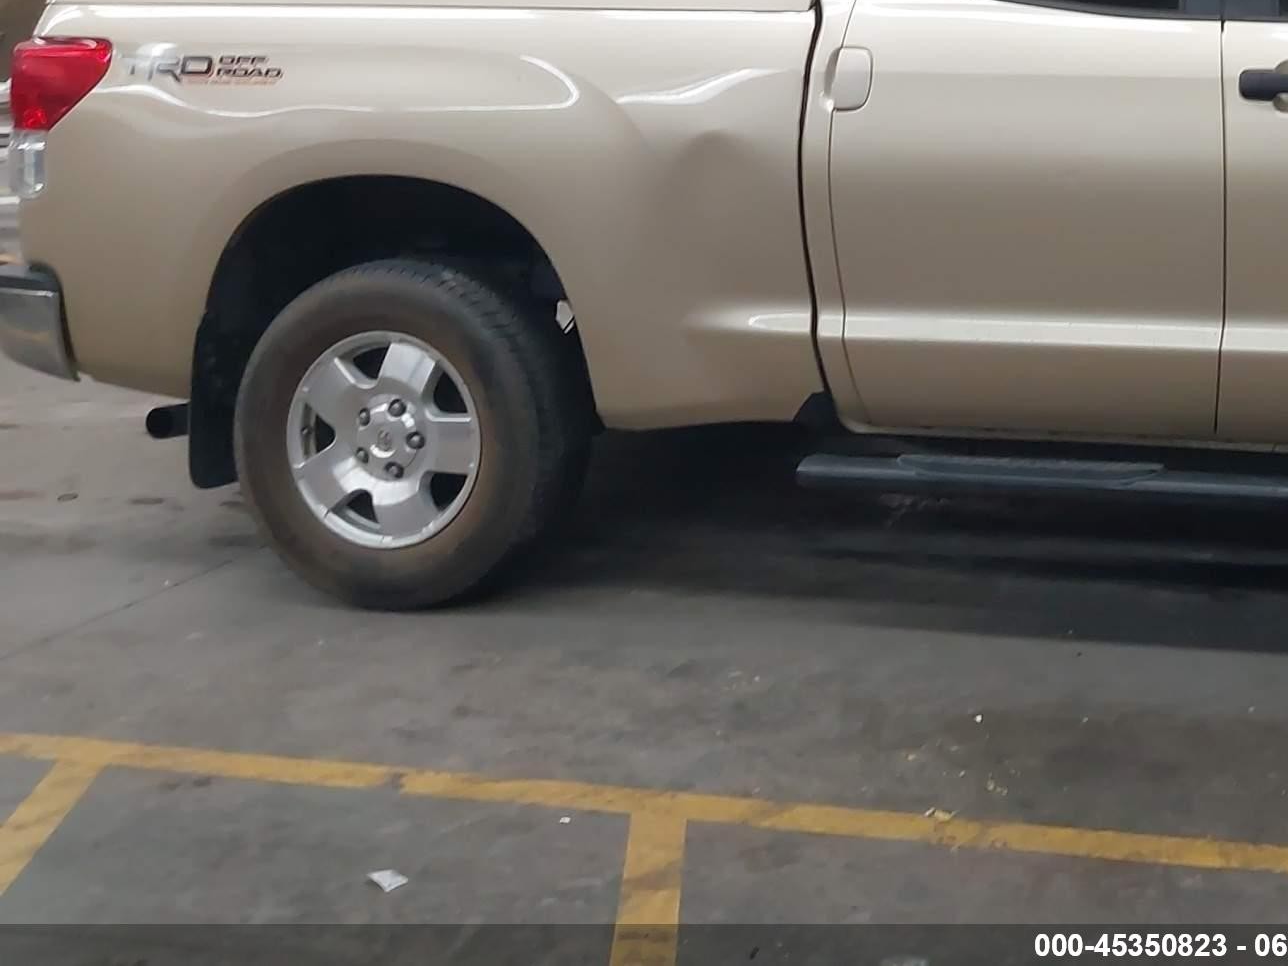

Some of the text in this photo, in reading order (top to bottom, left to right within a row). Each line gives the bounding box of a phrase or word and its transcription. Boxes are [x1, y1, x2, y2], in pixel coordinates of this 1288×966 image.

[218, 54, 268, 65] OFF
[122, 54, 213, 83] TRD
[216, 67, 282, 79] ROAD
